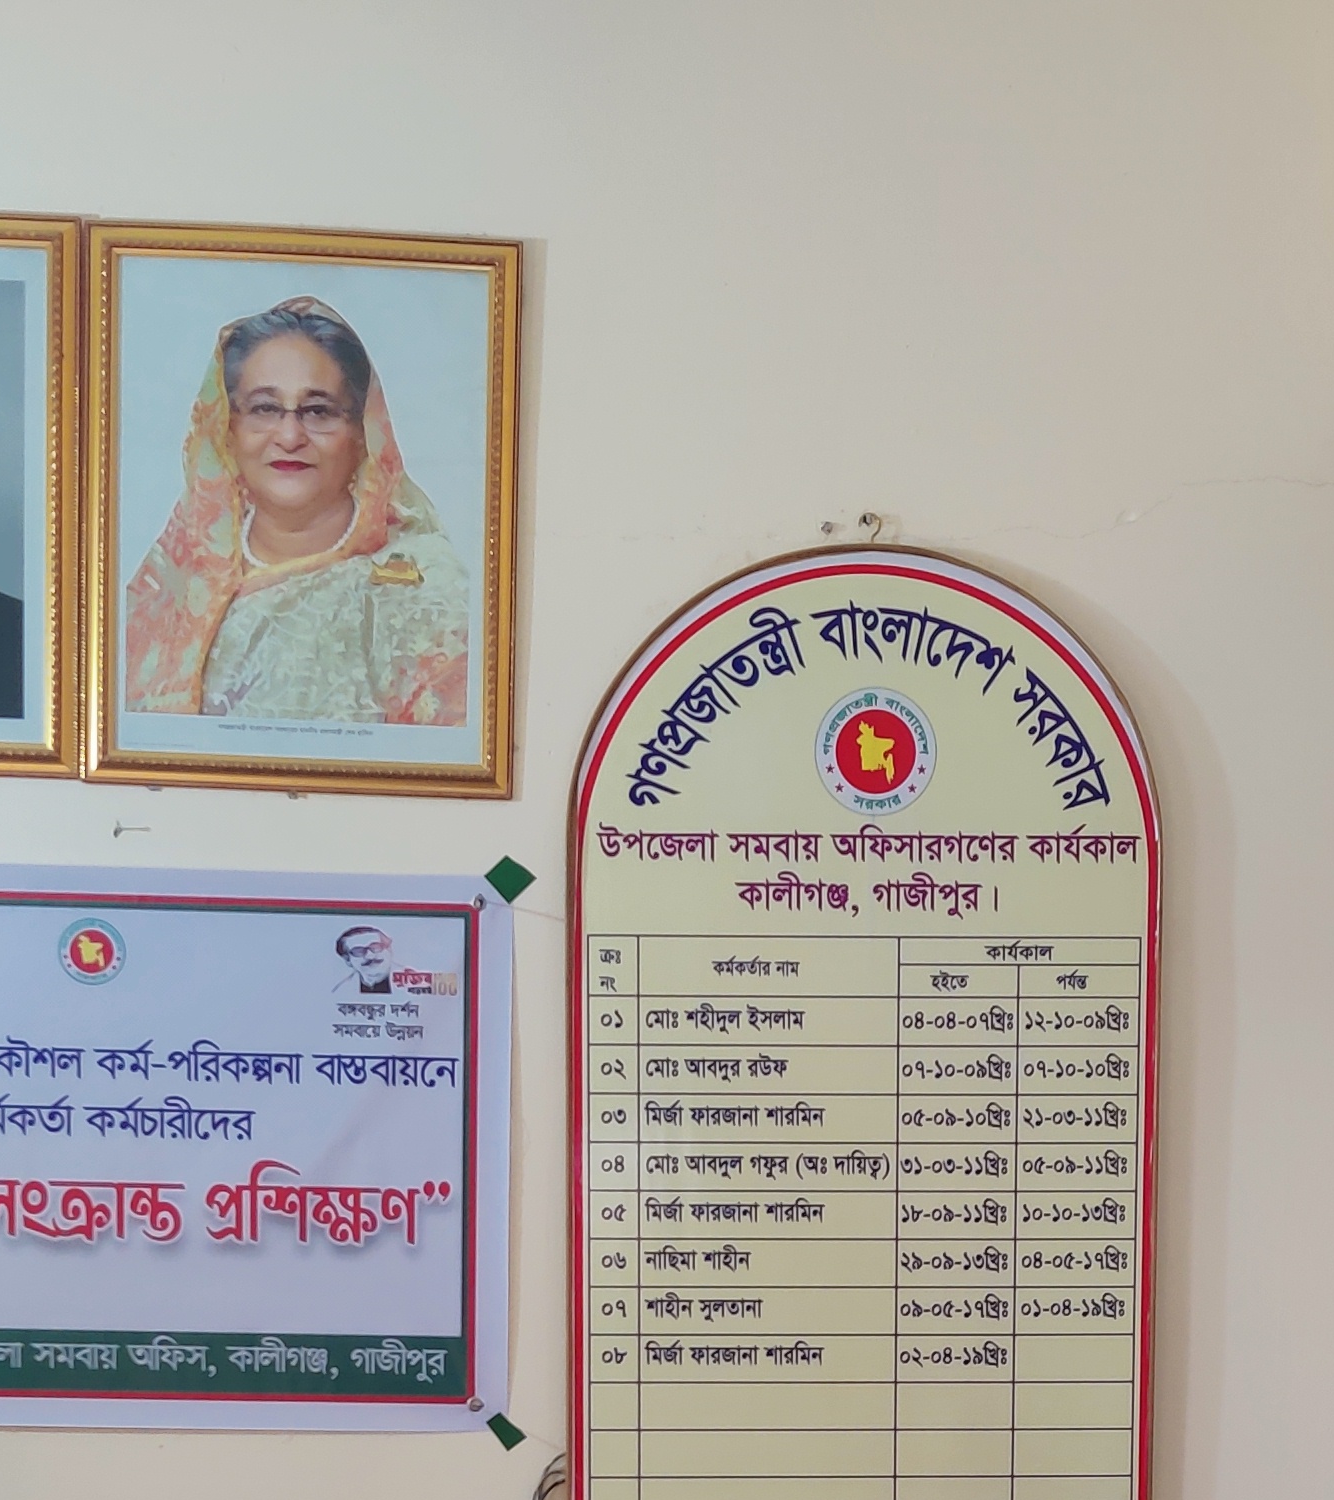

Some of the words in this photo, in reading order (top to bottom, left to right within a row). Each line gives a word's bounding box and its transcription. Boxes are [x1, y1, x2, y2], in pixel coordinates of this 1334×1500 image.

[625, 607, 806, 806] গণপ্রজাতন্ত্রী
[810, 599, 1015, 696] বাংলাদেশ
[1014, 666, 1111, 811] সরকার
[596, 822, 719, 862] উপজেলা
[726, 830, 823, 862] সমবায়
[830, 824, 1019, 863] অফিসারগণের
[1026, 824, 1141, 864] কার্যকাল
[735, 871, 859, 917] কালীগঞ্জ,
[985, 940, 1054, 961] কার্যকাল
[712, 956, 771, 976] কর্মকর্তার
[775, 961, 800, 977] নাম
[599, 976, 617, 992] নং
[930, 970, 969, 991] হইতে
[1056, 969, 1088, 990] পর্যন্ত
[390, 1001, 419, 1017] দর্শন
[601, 1010, 623, 1028] ০১
[646, 1009, 678, 1029] মোঃ
[684, 1003, 742, 1034] শহীদুল
[747, 1004, 805, 1031] ইসলাম
[385, 1022, 424, 1040] উন্নয়ন
[312, 1055, 459, 1087] বাস্তবায়নে
[601, 1059, 626, 1079] ০২
[646, 1057, 678, 1077] মোঃ
[684, 1059, 742, 1082] আবদুর
[747, 1053, 788, 1077] রউফ
[83, 1096, 256, 1140] কর্মচারীদের
[601, 1109, 626, 1124] ০৩
[644, 1100, 684, 1126] মির্জা
[689, 1106, 760, 1126] ফারজানা
[764, 1101, 825, 1126] শারমিন
[602, 1155, 624, 1172] ০৪
[646, 1154, 678, 1174] মোঃ
[685, 1155, 744, 1179] আবদুল
[750, 1155, 789, 1180] গফুর
[796, 1153, 827, 1179] (অঃ
[833, 1150, 889, 1180] দায়িত্ব)
[602, 1204, 626, 1221] ০৫
[645, 1196, 684, 1222] মির্জা
[689, 1202, 760, 1222] ফারজানা
[764, 1198, 825, 1222] শারমিন
[602, 1252, 626, 1269] ০৬
[644, 1245, 697, 1272] নাছিমা
[702, 1245, 751, 1271] শাহীন
[602, 1300, 626, 1317] ০৭
[645, 1292, 694, 1319] শাহীন
[30, 1343, 120, 1369] সমবায়
[126, 1335, 216, 1377] অফিস,
[226, 1336, 338, 1379] কালীগঞ্জ,
[351, 1338, 448, 1383] গাজীপুর
[602, 1348, 627, 1364] ০৮
[644, 1340, 684, 1365] মির্জা
[689, 1345, 759, 1365] ফারজানা
[764, 1341, 824, 1365] শারমিন
